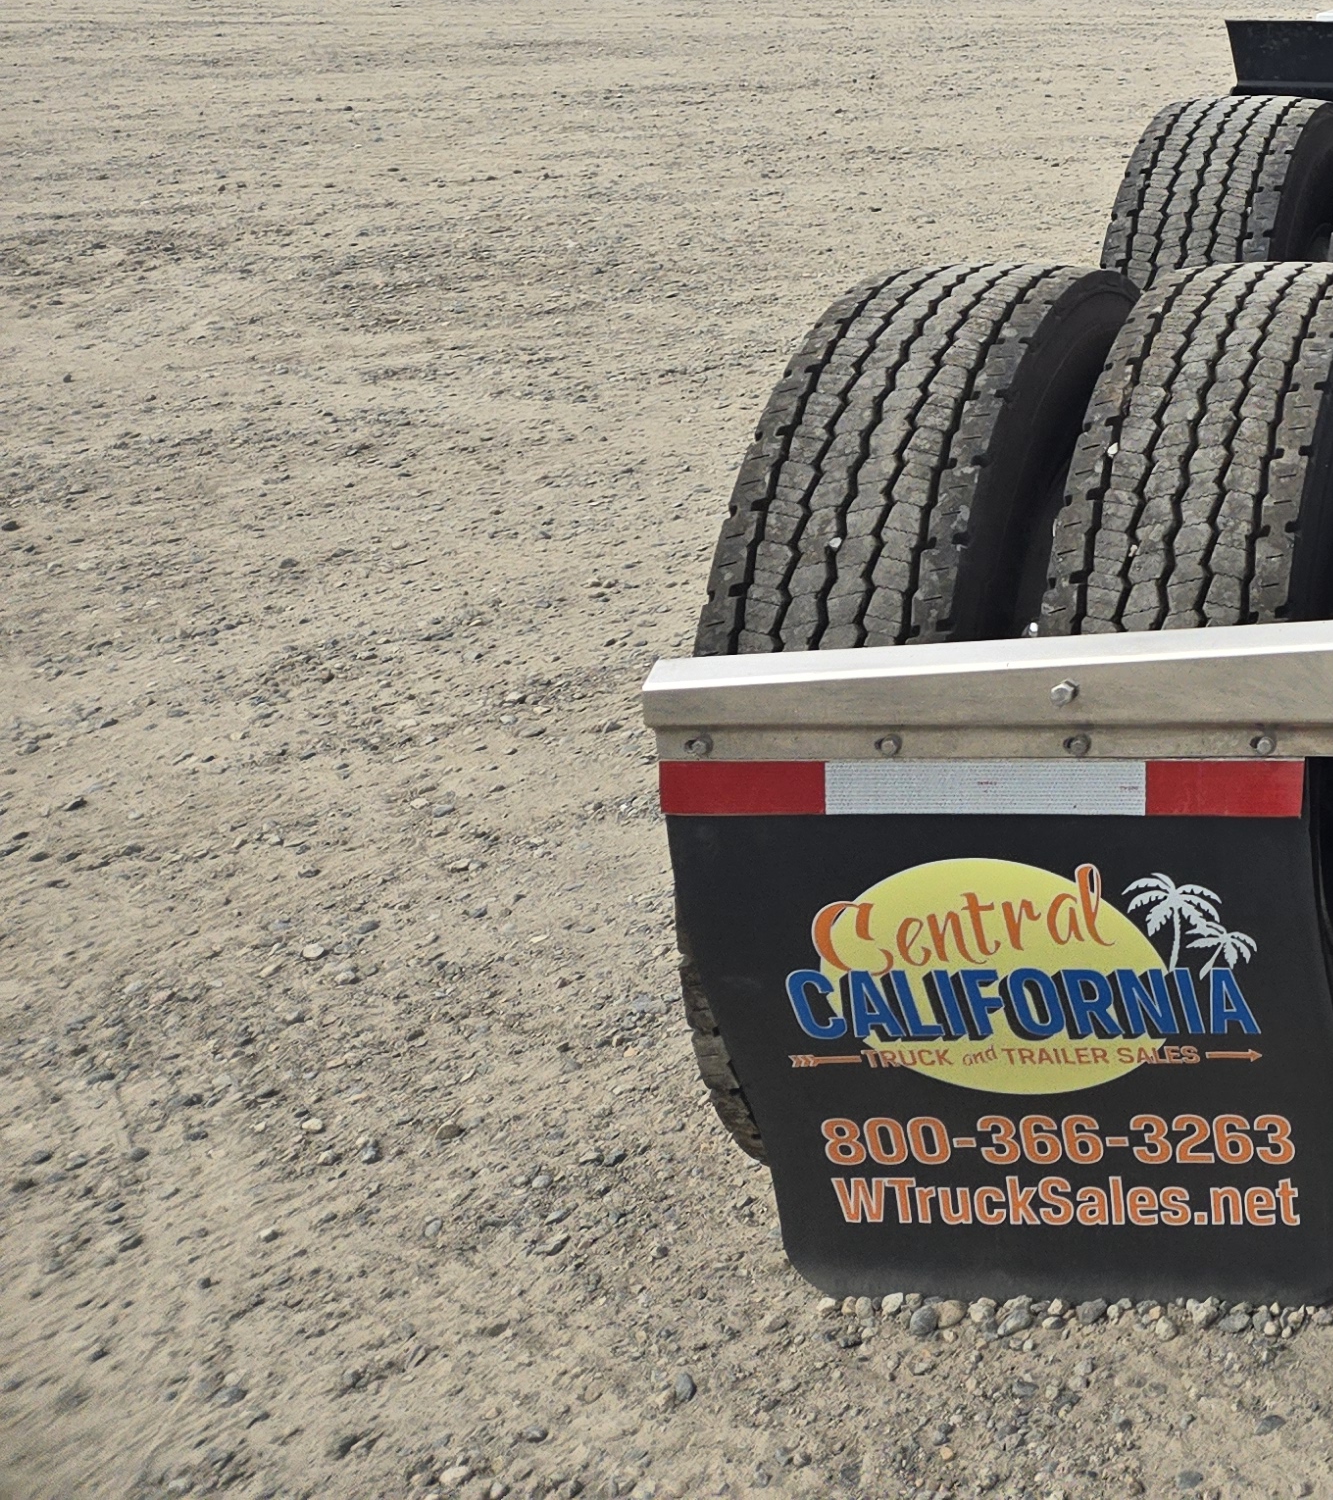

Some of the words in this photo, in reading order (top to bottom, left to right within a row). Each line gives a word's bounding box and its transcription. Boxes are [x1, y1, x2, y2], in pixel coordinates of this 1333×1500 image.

[810, 863, 1116, 977] Central
[785, 966, 1261, 1043] CALIFORNIA
[860, 1047, 952, 1069] TRUCK
[962, 1044, 998, 1067] and
[1000, 1046, 1110, 1066] TRAILER
[1116, 1044, 1200, 1065] SALES
[820, 1113, 1296, 1166] 800-366-3263
[831, 1175, 1300, 1226] WTruckSales.net
